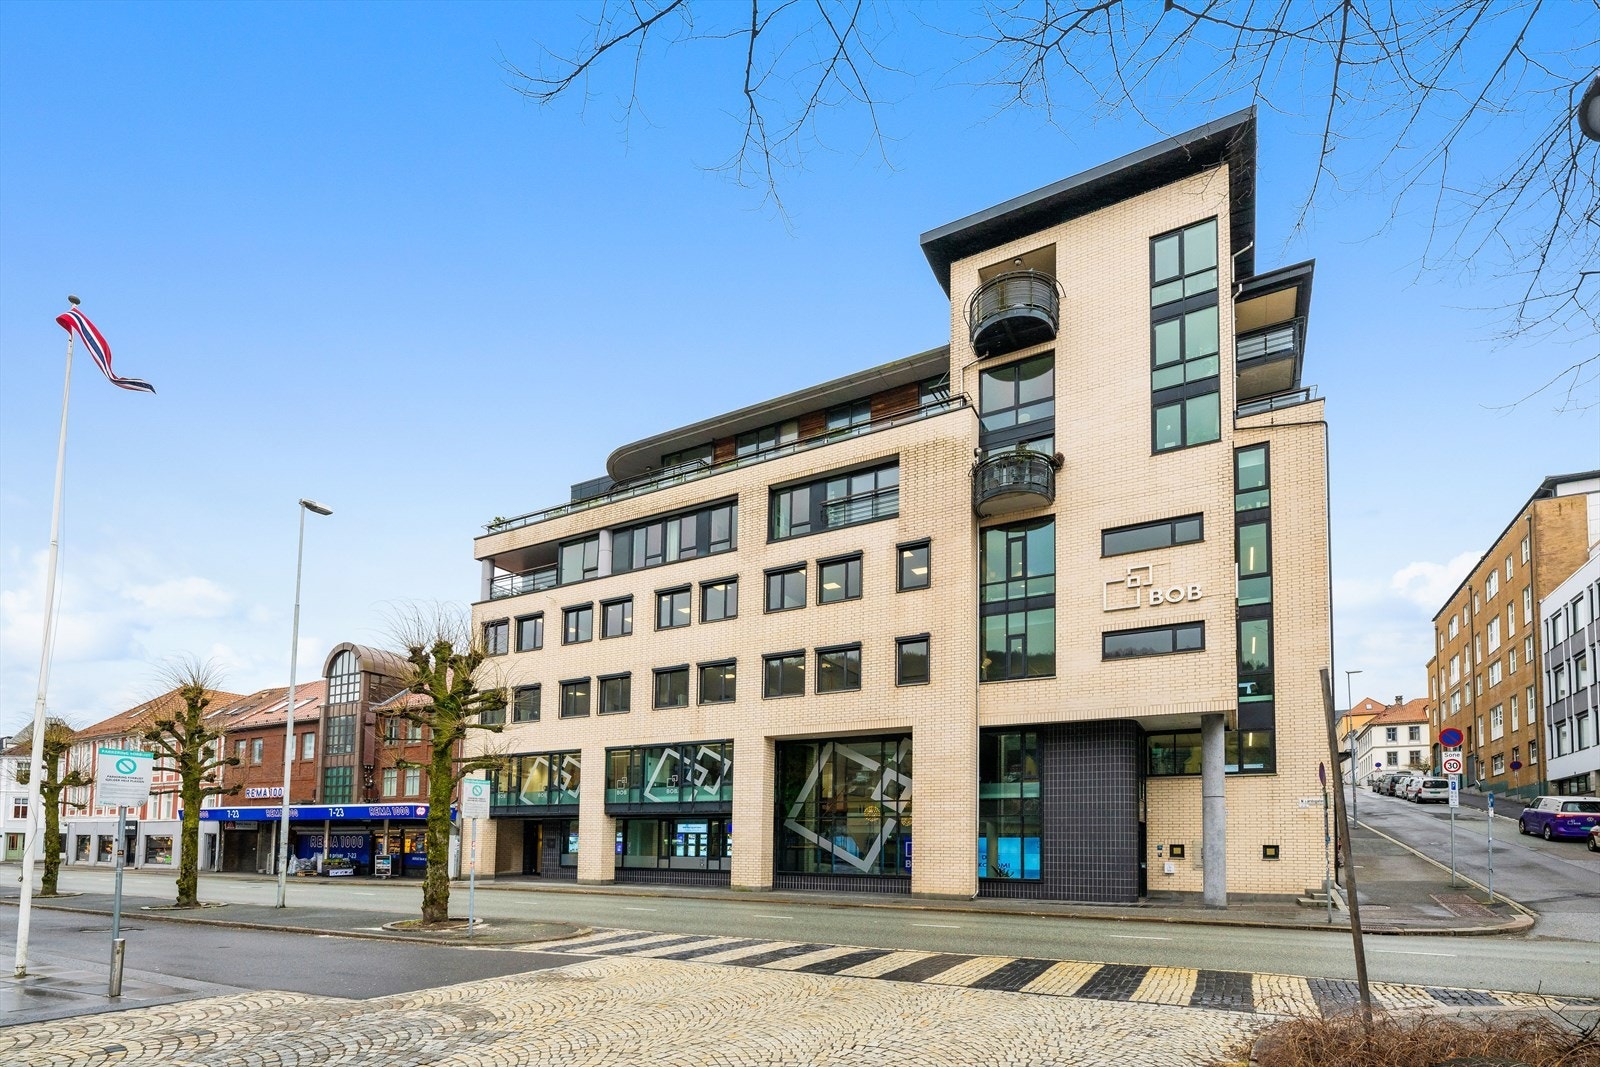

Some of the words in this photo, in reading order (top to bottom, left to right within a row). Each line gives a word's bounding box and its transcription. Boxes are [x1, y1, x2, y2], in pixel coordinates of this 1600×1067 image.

[1149, 584, 1203, 606] BOB
[1447, 762, 1458, 770] 30
[245, 788, 269, 798] REMA
[269, 787, 284, 798] 100
[227, 810, 240, 819] 7-23
[328, 808, 345, 817] 7-23
[368, 806, 391, 816] REMA
[392, 806, 410, 816] 1000
[340, 835, 364, 848] 1000
